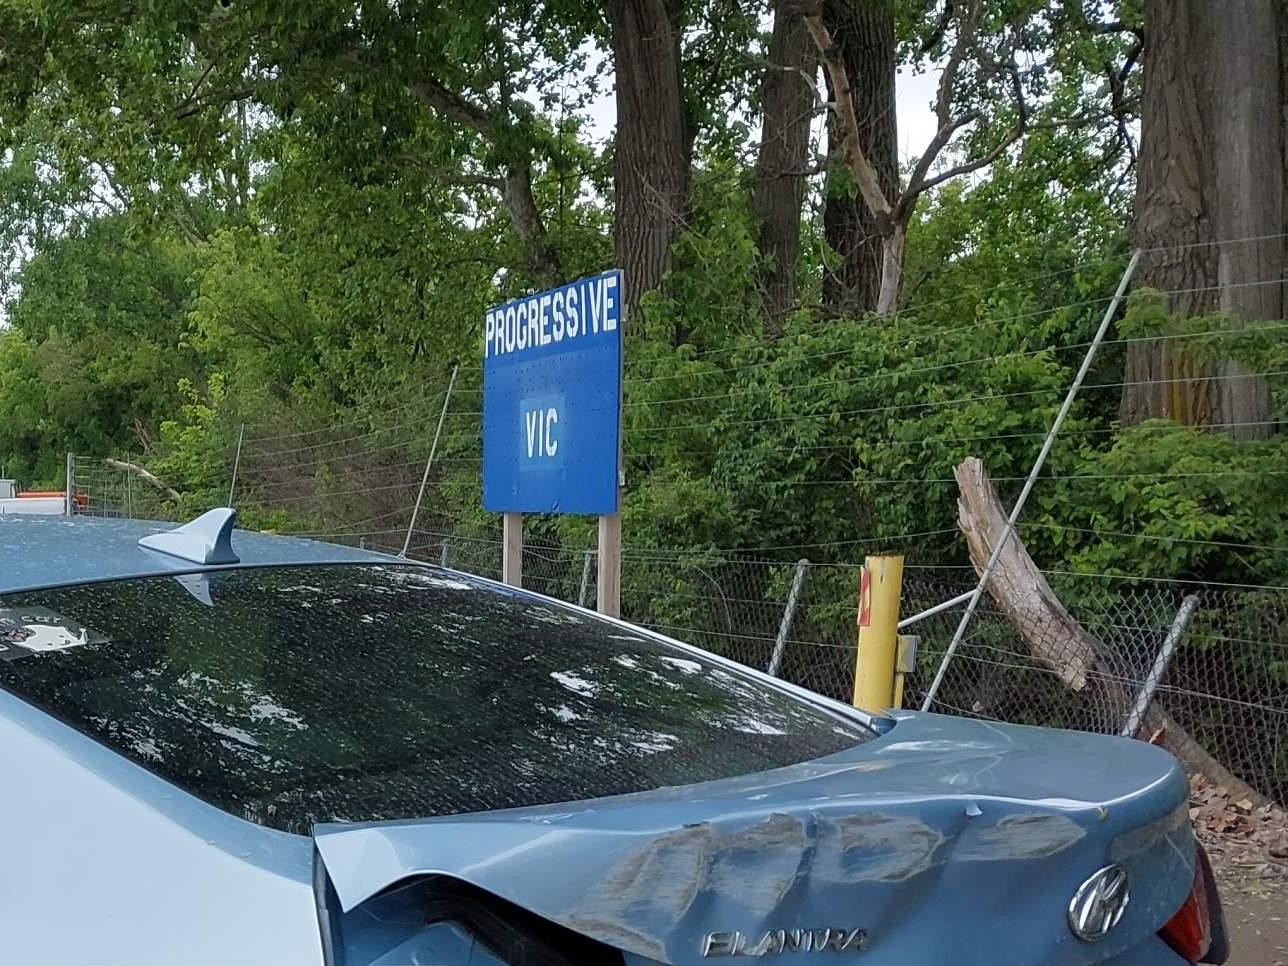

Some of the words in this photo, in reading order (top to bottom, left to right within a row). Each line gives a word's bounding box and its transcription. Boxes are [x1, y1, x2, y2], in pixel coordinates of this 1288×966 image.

[485, 276, 617, 358] PROGRESSIVE
[525, 407, 558, 458] VIC
[20, 615, 62, 624] car
[702, 928, 870, 958] ELANTRA
